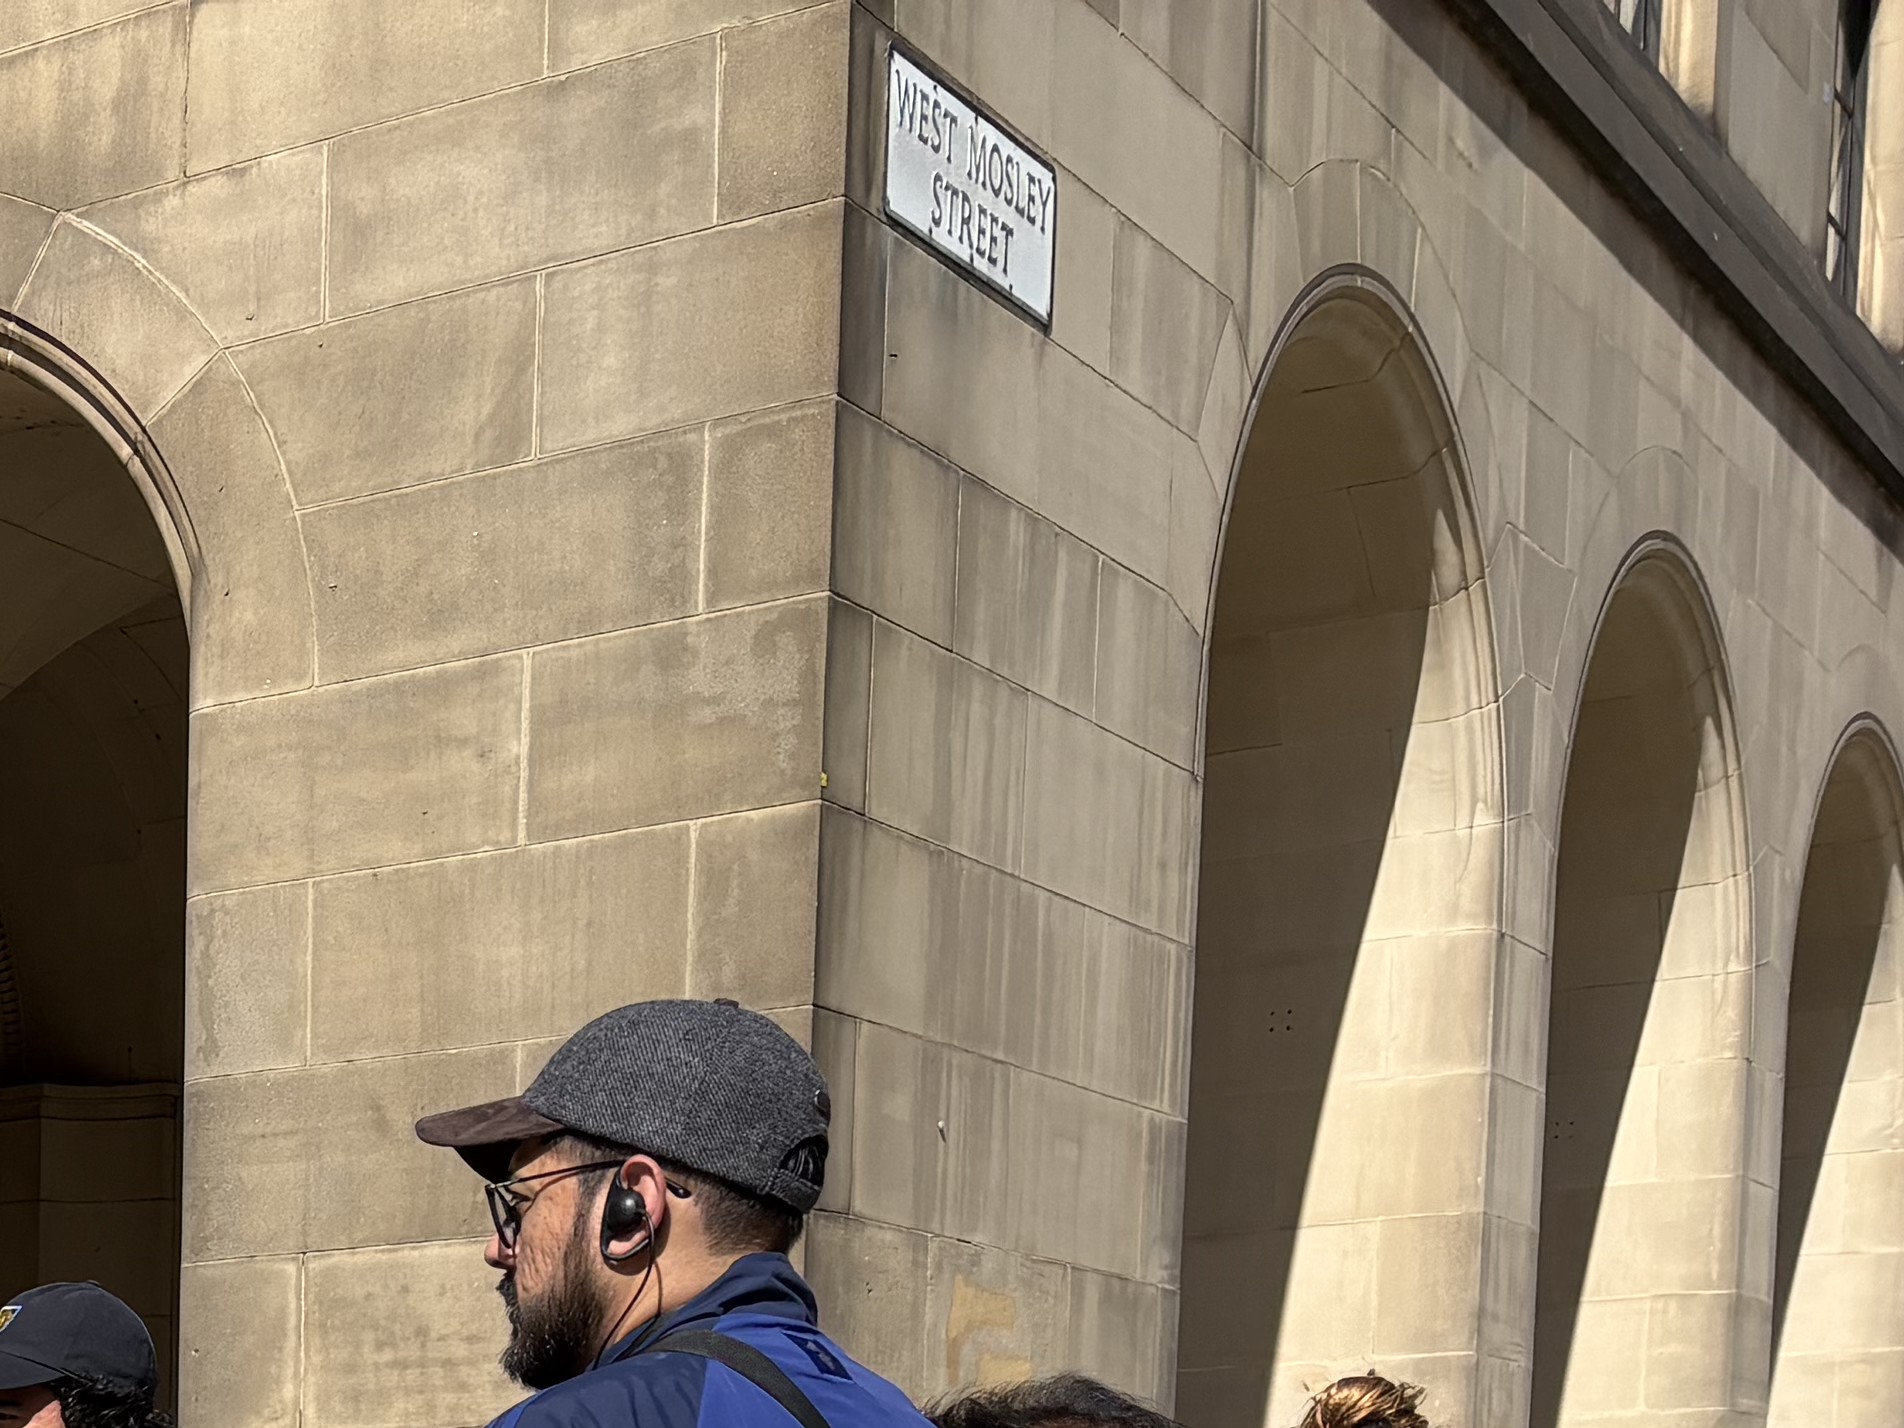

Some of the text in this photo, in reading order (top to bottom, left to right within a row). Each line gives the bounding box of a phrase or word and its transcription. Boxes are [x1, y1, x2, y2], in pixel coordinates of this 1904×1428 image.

[895, 69, 1052, 236] WEST MOSLEY
[931, 171, 1014, 277] STREET
